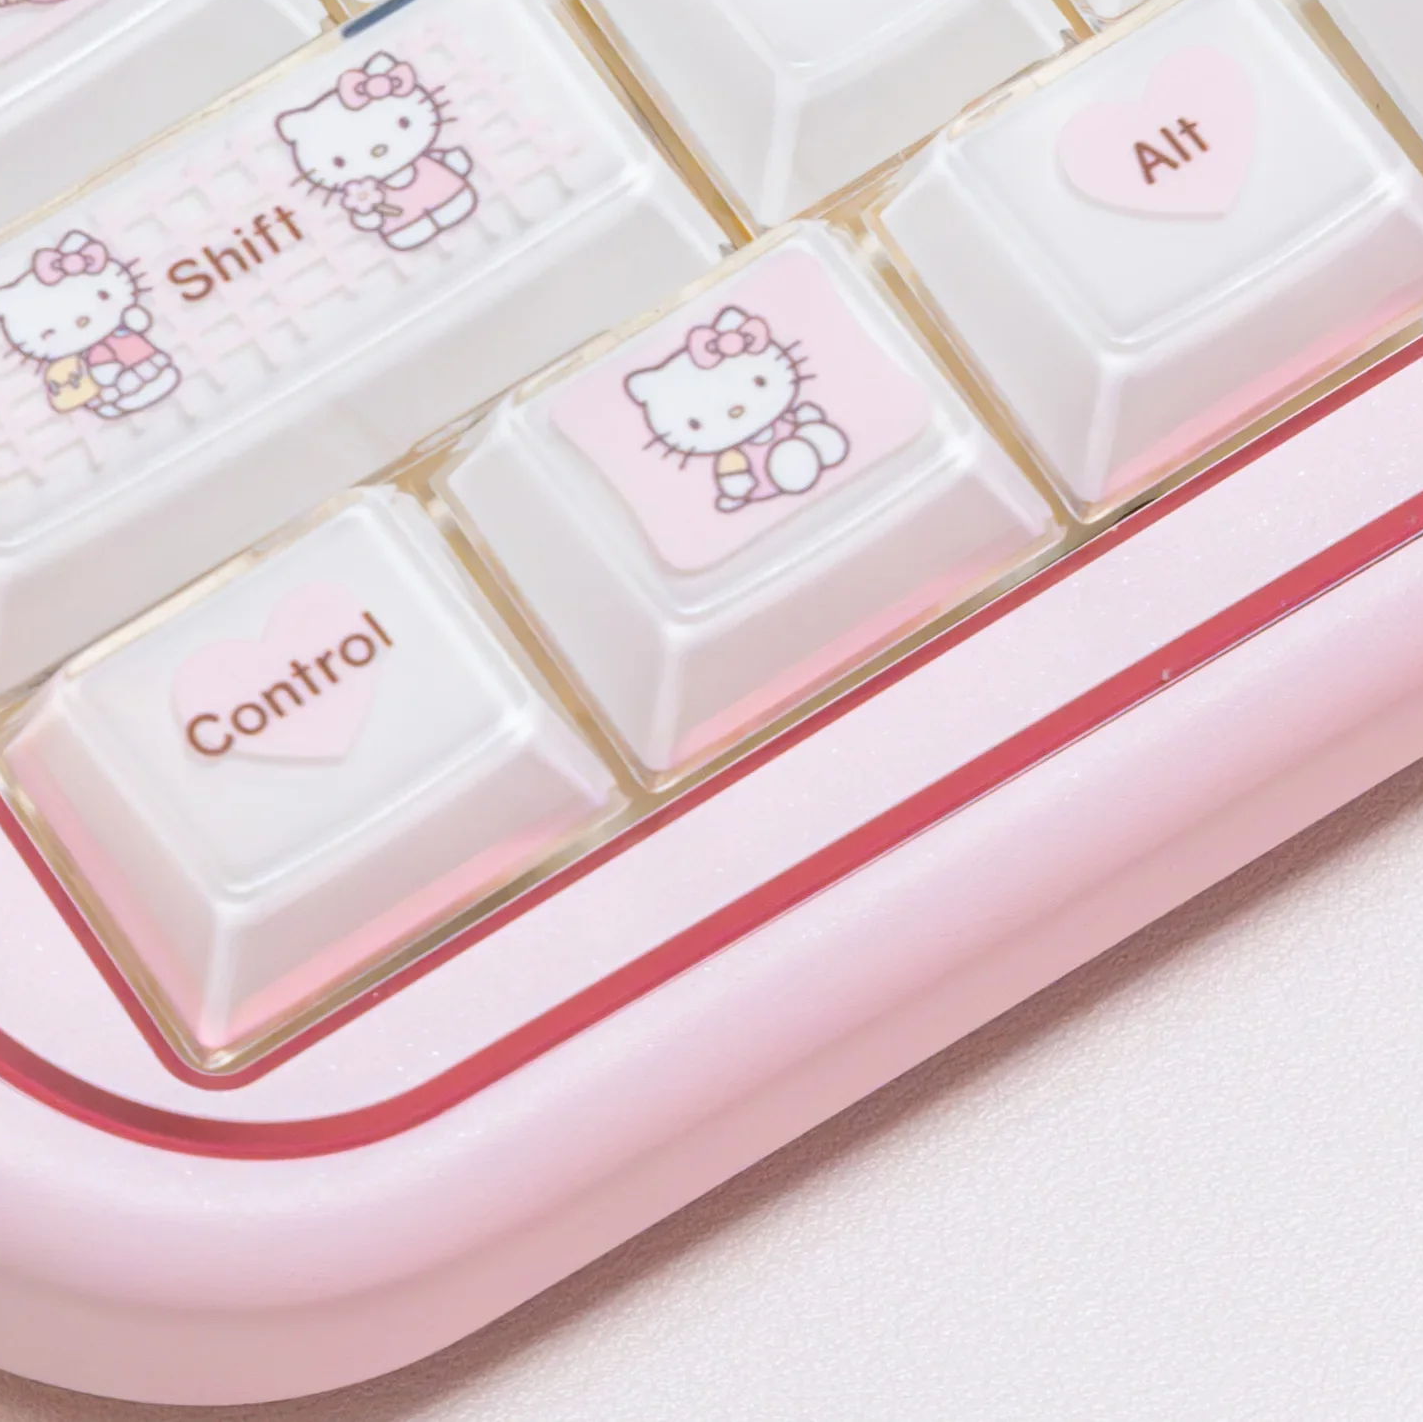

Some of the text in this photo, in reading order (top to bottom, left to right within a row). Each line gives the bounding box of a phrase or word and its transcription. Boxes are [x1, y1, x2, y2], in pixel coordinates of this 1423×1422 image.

[1133, 117, 1209, 186] Alt
[166, 204, 304, 303] Shift
[184, 610, 394, 758] Control
